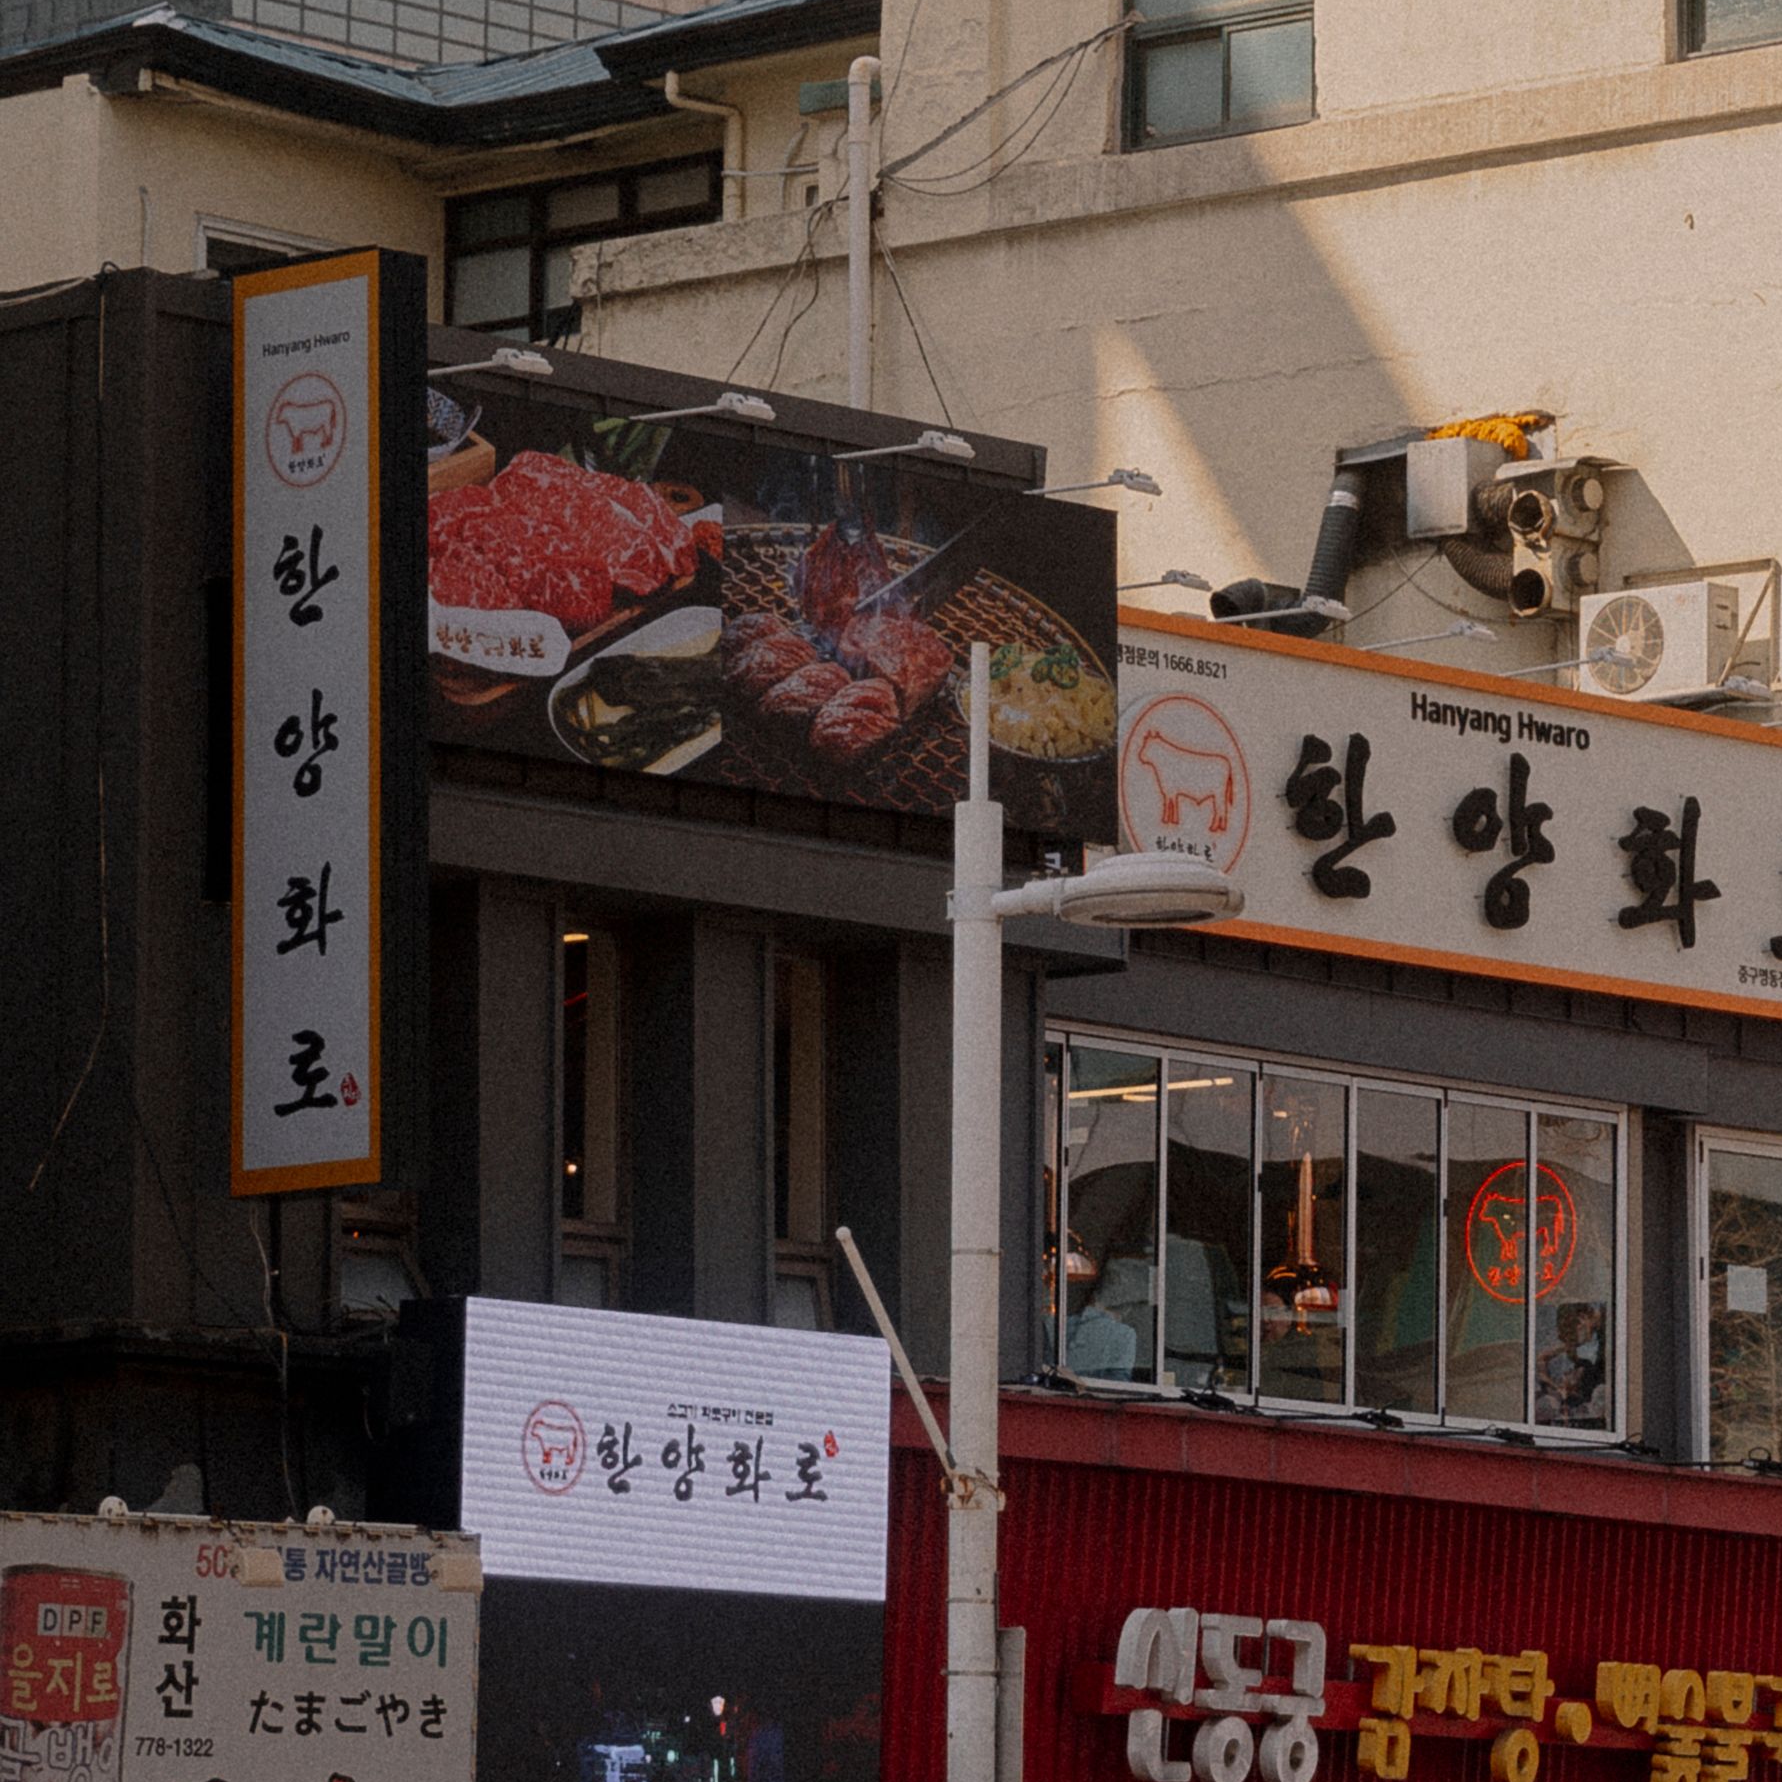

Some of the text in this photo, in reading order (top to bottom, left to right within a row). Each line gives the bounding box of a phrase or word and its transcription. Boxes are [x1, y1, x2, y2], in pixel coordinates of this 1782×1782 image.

[262, 331, 350, 357] Hanyang Hwaro
[1410, 690, 1590, 752] Hanyang Hwaro
[272, 524, 343, 1119] 한양화로
[597, 1422, 828, 1503] 한양화로
[315, 1548, 430, 1586] 자연산골뱅
[41, 1607, 105, 1635] DPF
[244, 1610, 449, 1668] 계란말이
[8, 1642, 119, 1714] 을지로
[156, 1594, 202, 1719] 화산
[249, 1689, 448, 1740] たまごやき
[134, 1736, 215, 1759] 778-1322
